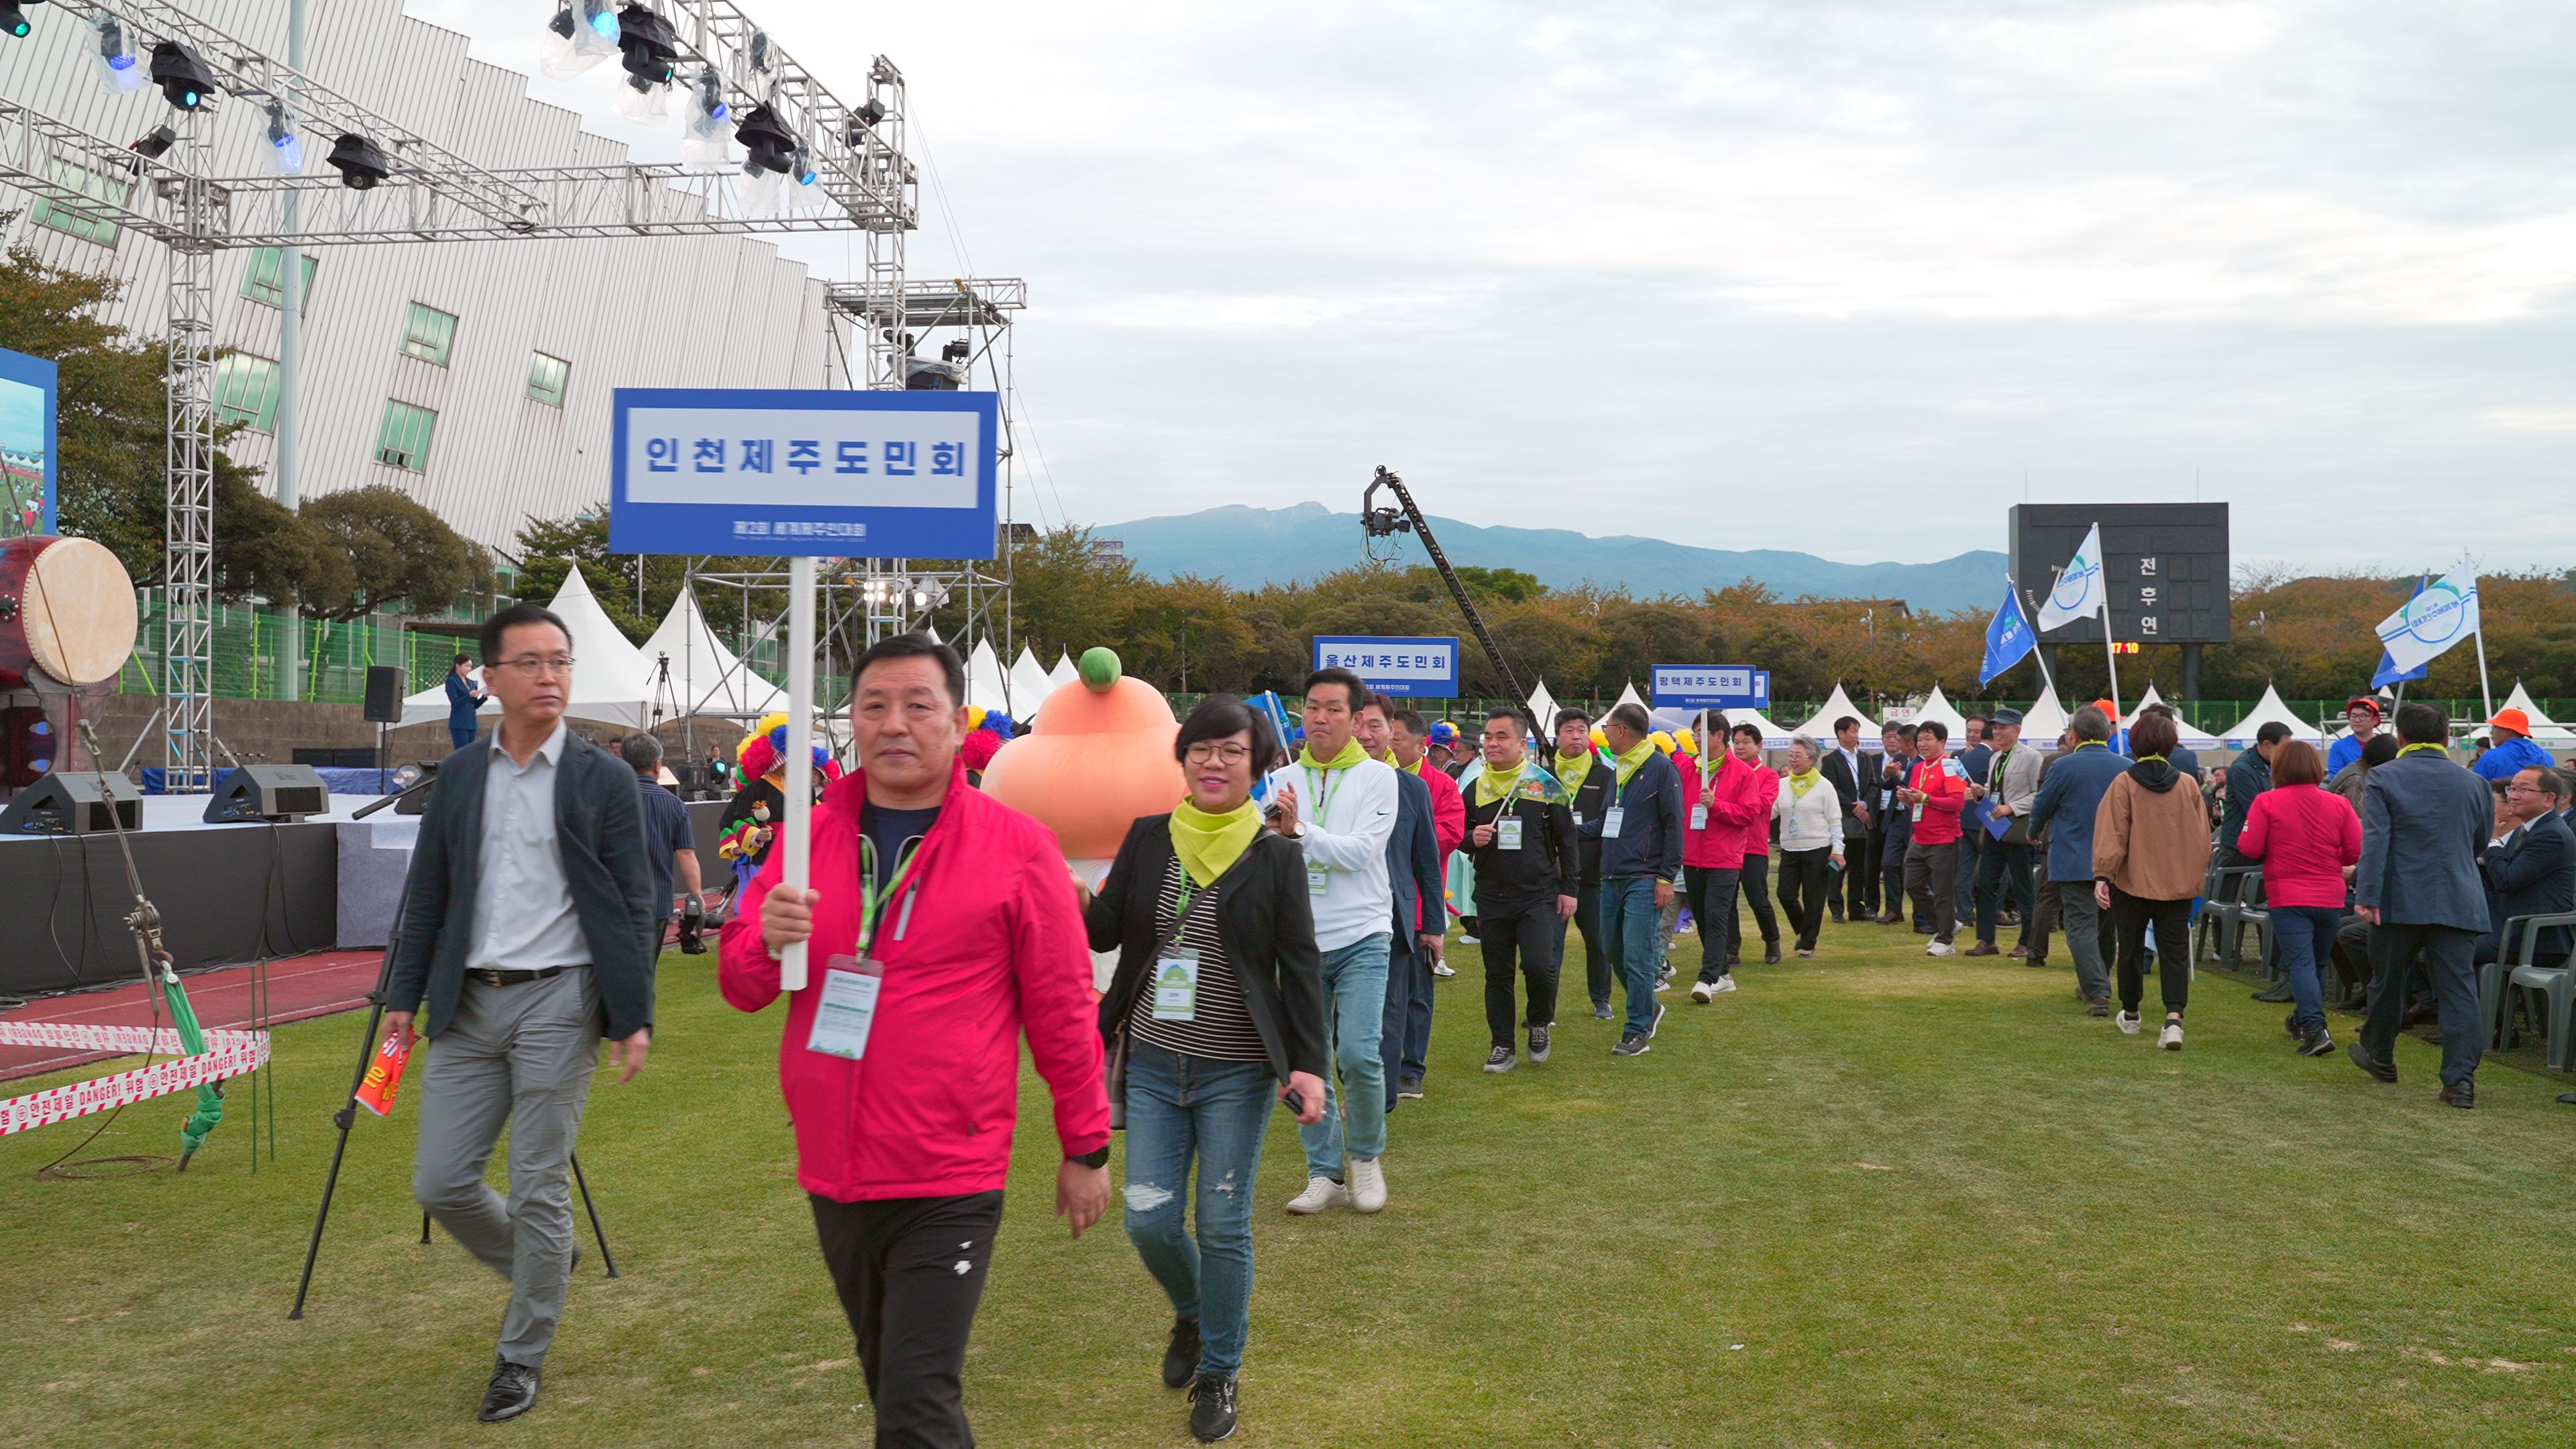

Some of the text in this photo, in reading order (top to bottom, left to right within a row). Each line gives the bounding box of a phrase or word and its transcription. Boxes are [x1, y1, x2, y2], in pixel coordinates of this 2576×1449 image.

[645, 437, 965, 477] 인천제주도민회
[2111, 642, 2139, 654] 17:10
[1326, 653, 1446, 669] 울산제주도민회
[1659, 676, 1741, 687] 평택제주도민회
[30, 1094, 74, 1118] 안전제일
[80, 1083, 121, 1106] DANGER!
[125, 1077, 144, 1094] 위험
[160, 1064, 197, 1086] 안전제일
[201, 1055, 236, 1075] DANGER!
[240, 1050, 256, 1065] 위험
